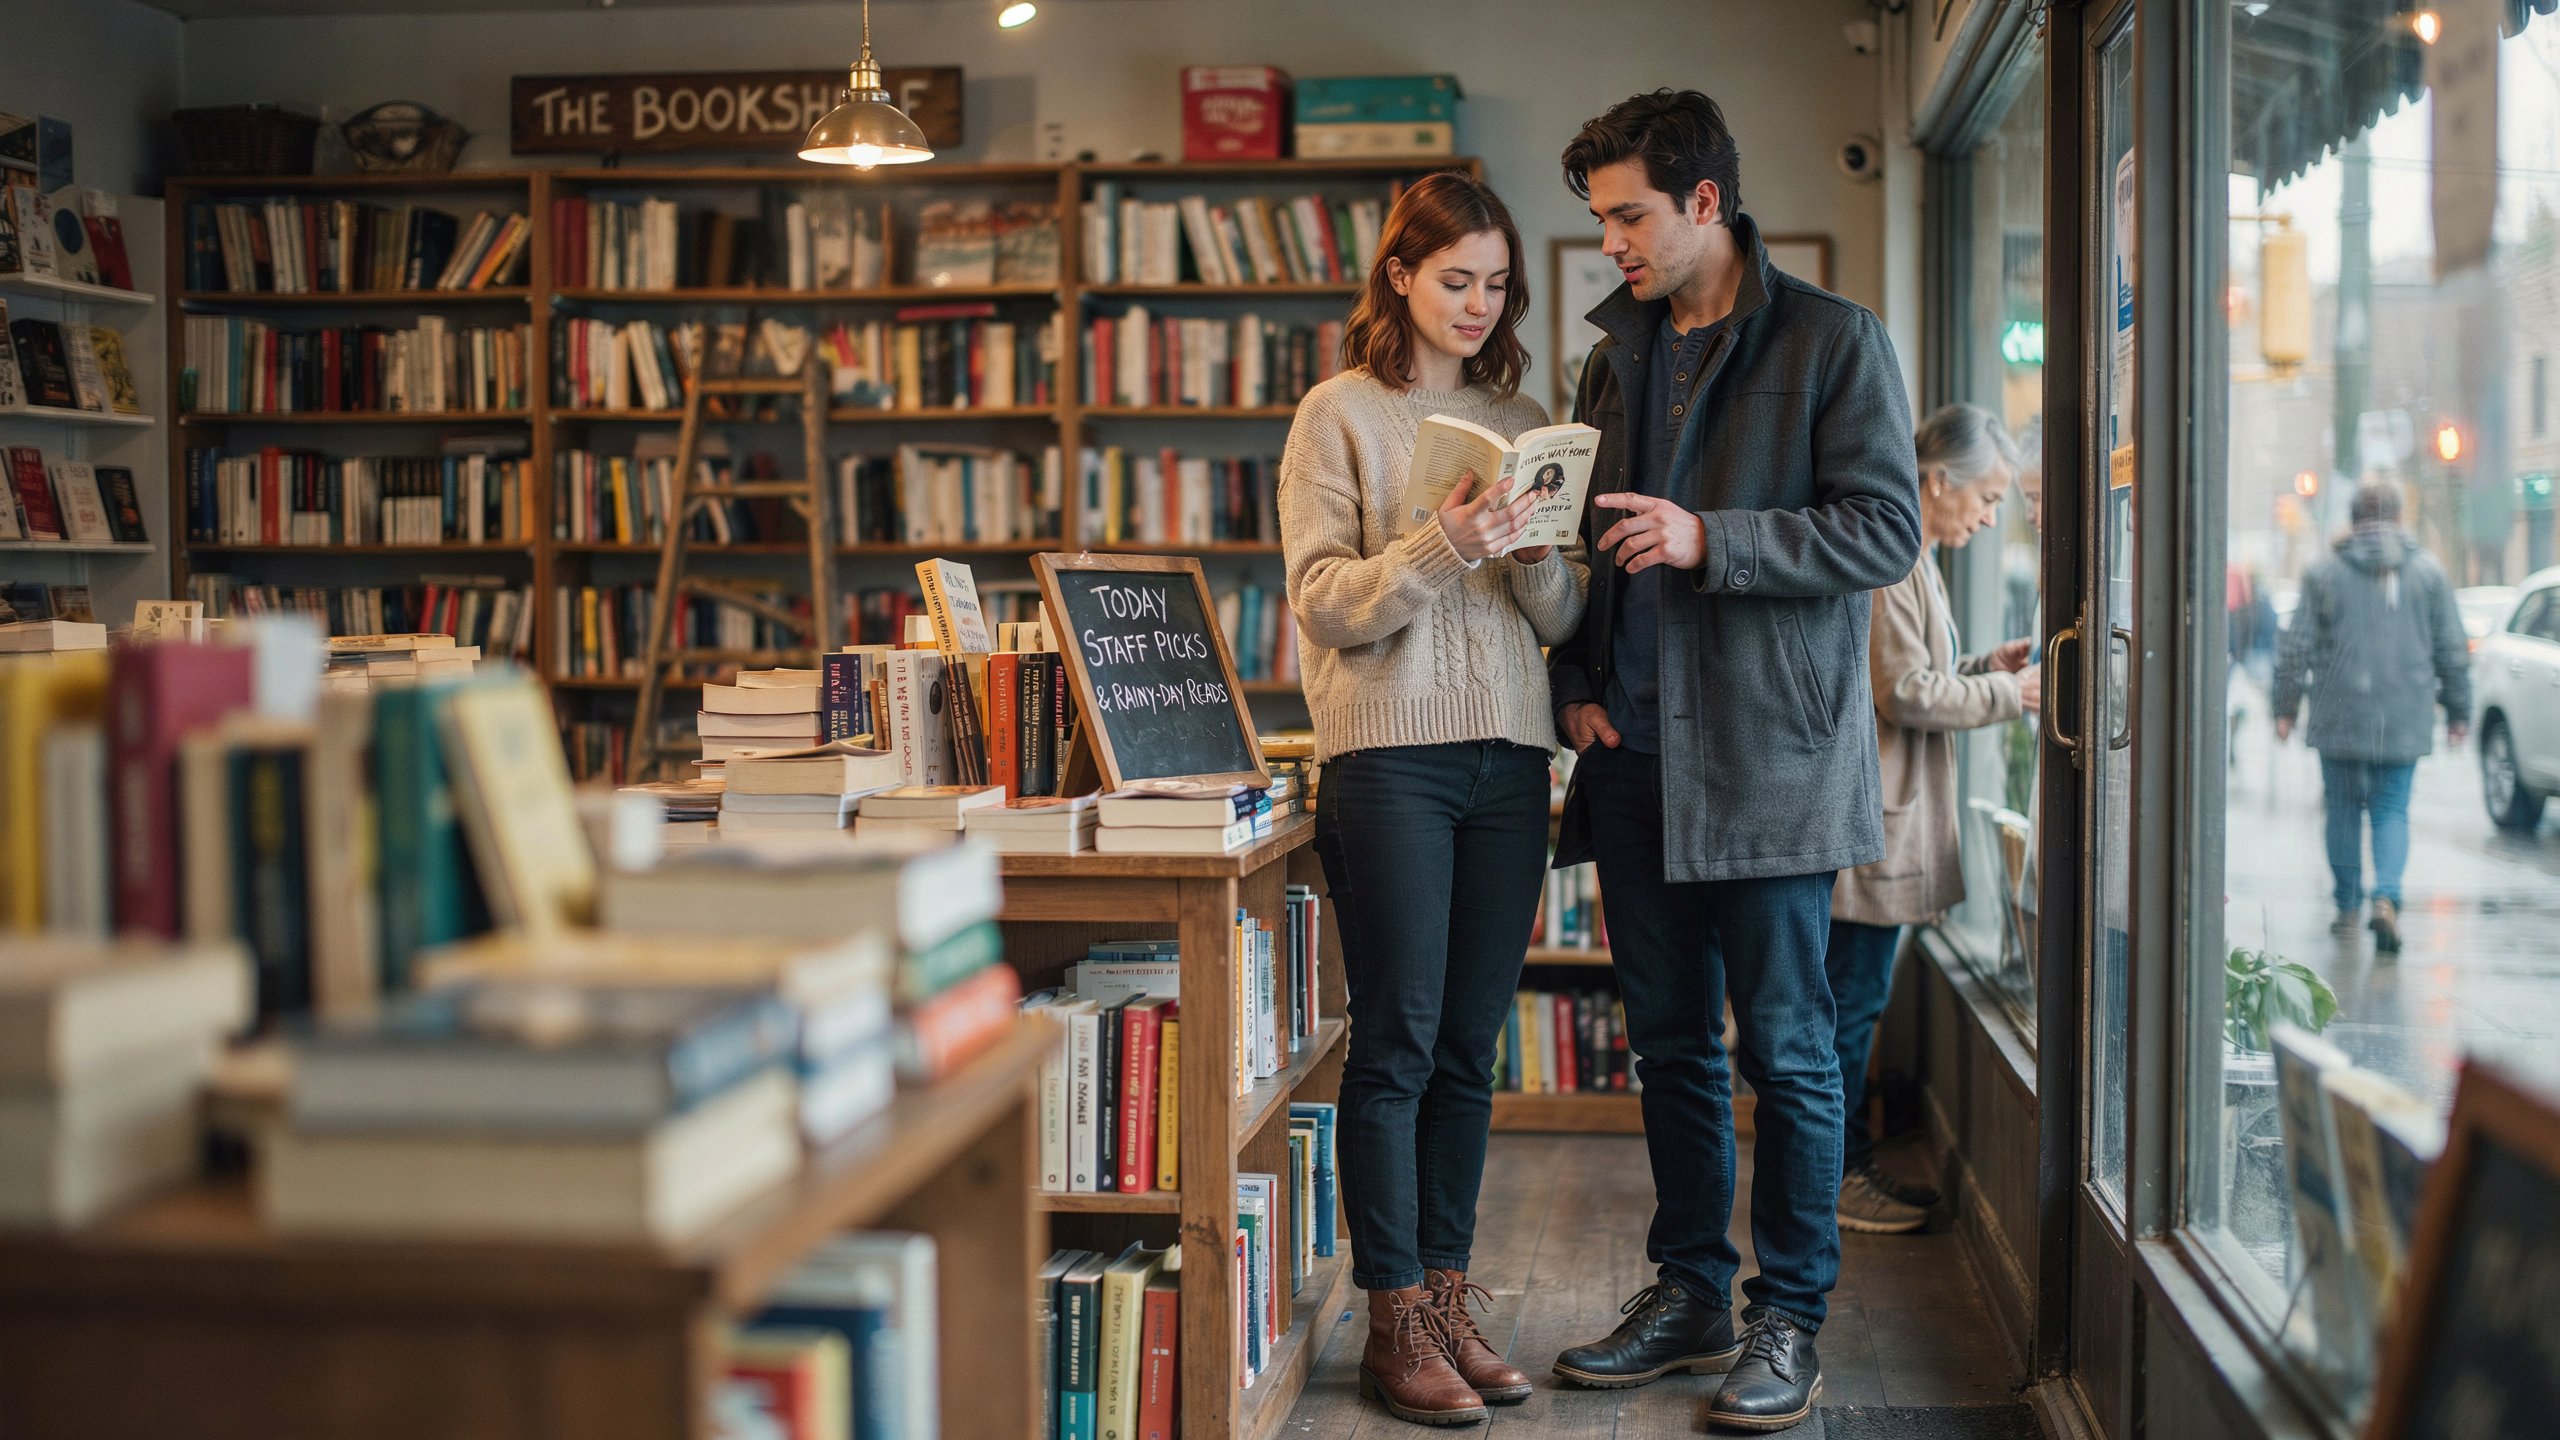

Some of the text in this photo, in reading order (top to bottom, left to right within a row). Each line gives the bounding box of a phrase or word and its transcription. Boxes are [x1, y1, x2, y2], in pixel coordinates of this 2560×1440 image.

[532, 79, 931, 140] THE BOOKSHF
[1547, 447, 1568, 459] WAY
[1089, 584, 1167, 623] TODAY
[1083, 629, 1208, 667] STAFF PICKS
[1096, 678, 1229, 714] & RAINY-DAY READS
